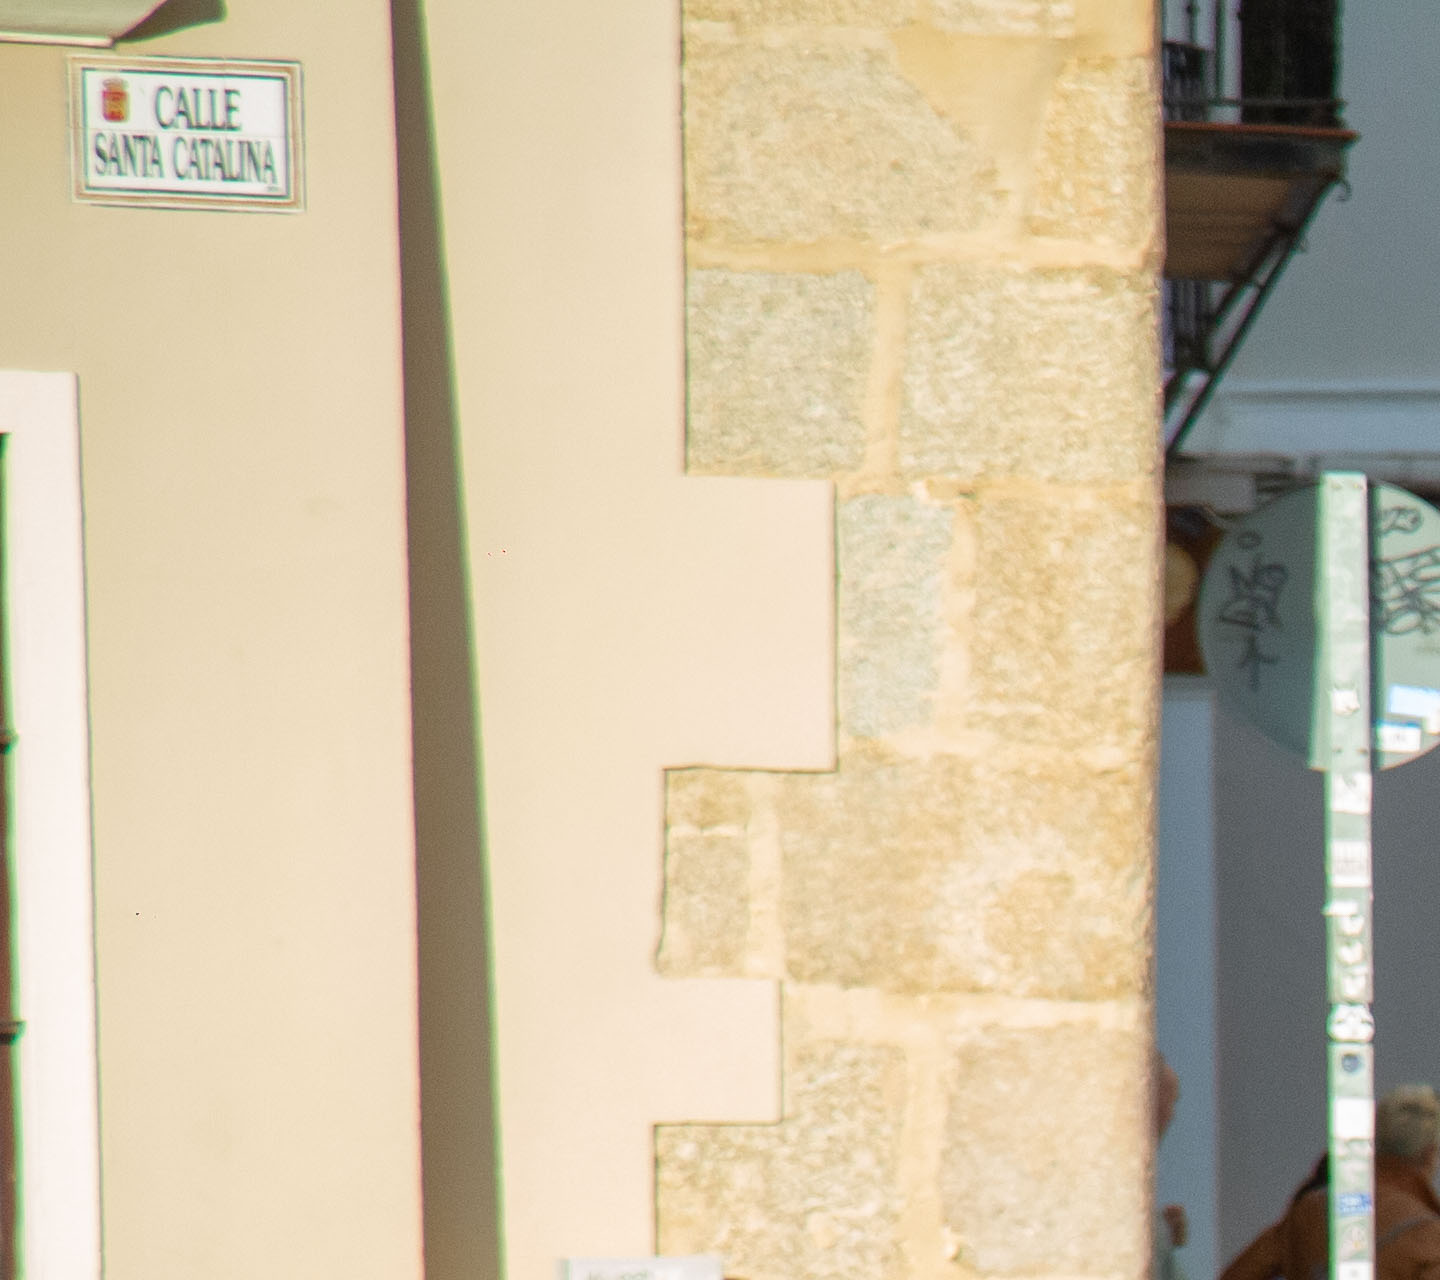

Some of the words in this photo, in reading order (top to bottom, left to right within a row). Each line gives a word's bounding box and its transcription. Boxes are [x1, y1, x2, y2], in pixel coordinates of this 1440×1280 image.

[154, 85, 242, 131] CALLE
[95, 131, 165, 178] SANTA
[172, 136, 279, 184] CATALINA
